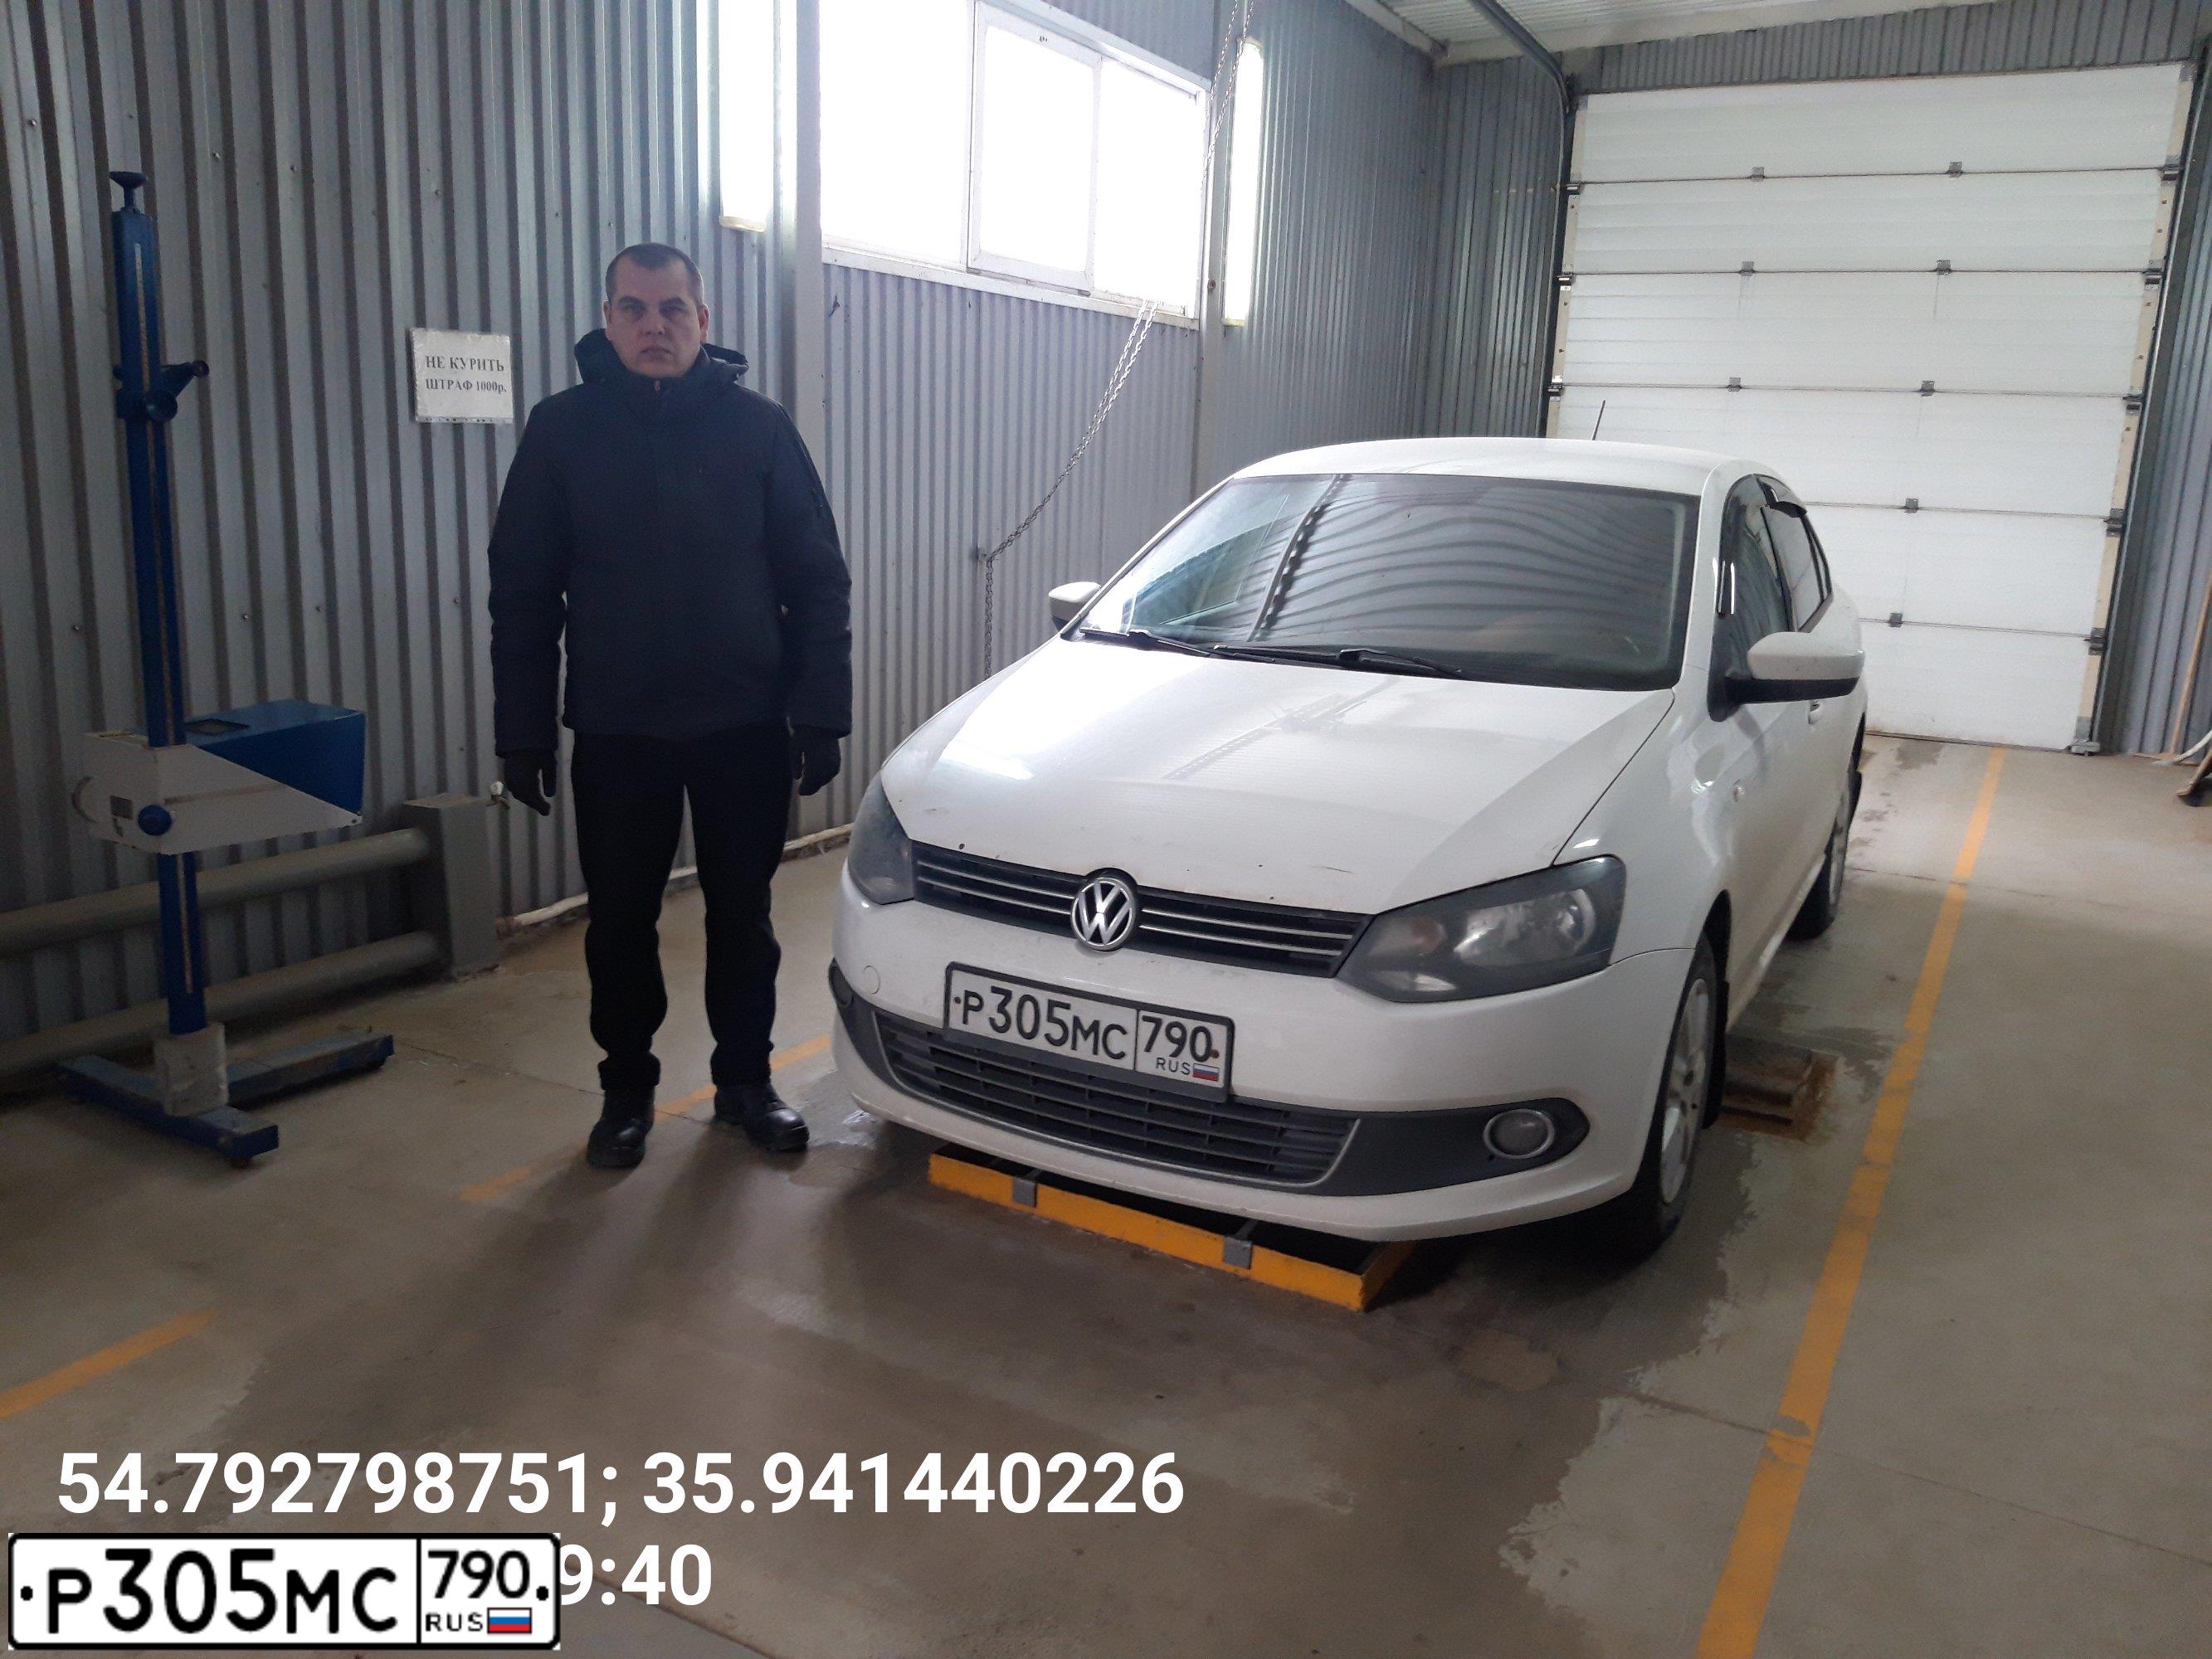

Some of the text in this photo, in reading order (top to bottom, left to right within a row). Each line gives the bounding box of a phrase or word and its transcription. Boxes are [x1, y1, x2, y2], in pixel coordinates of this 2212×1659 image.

[426, 355, 504, 372] НЕ КУРИТЬ
[426, 378, 507, 395] ШТРАФ 1000р.
[1142, 1014, 1212, 1063] 790
[1156, 1057, 1191, 1076] RUS
